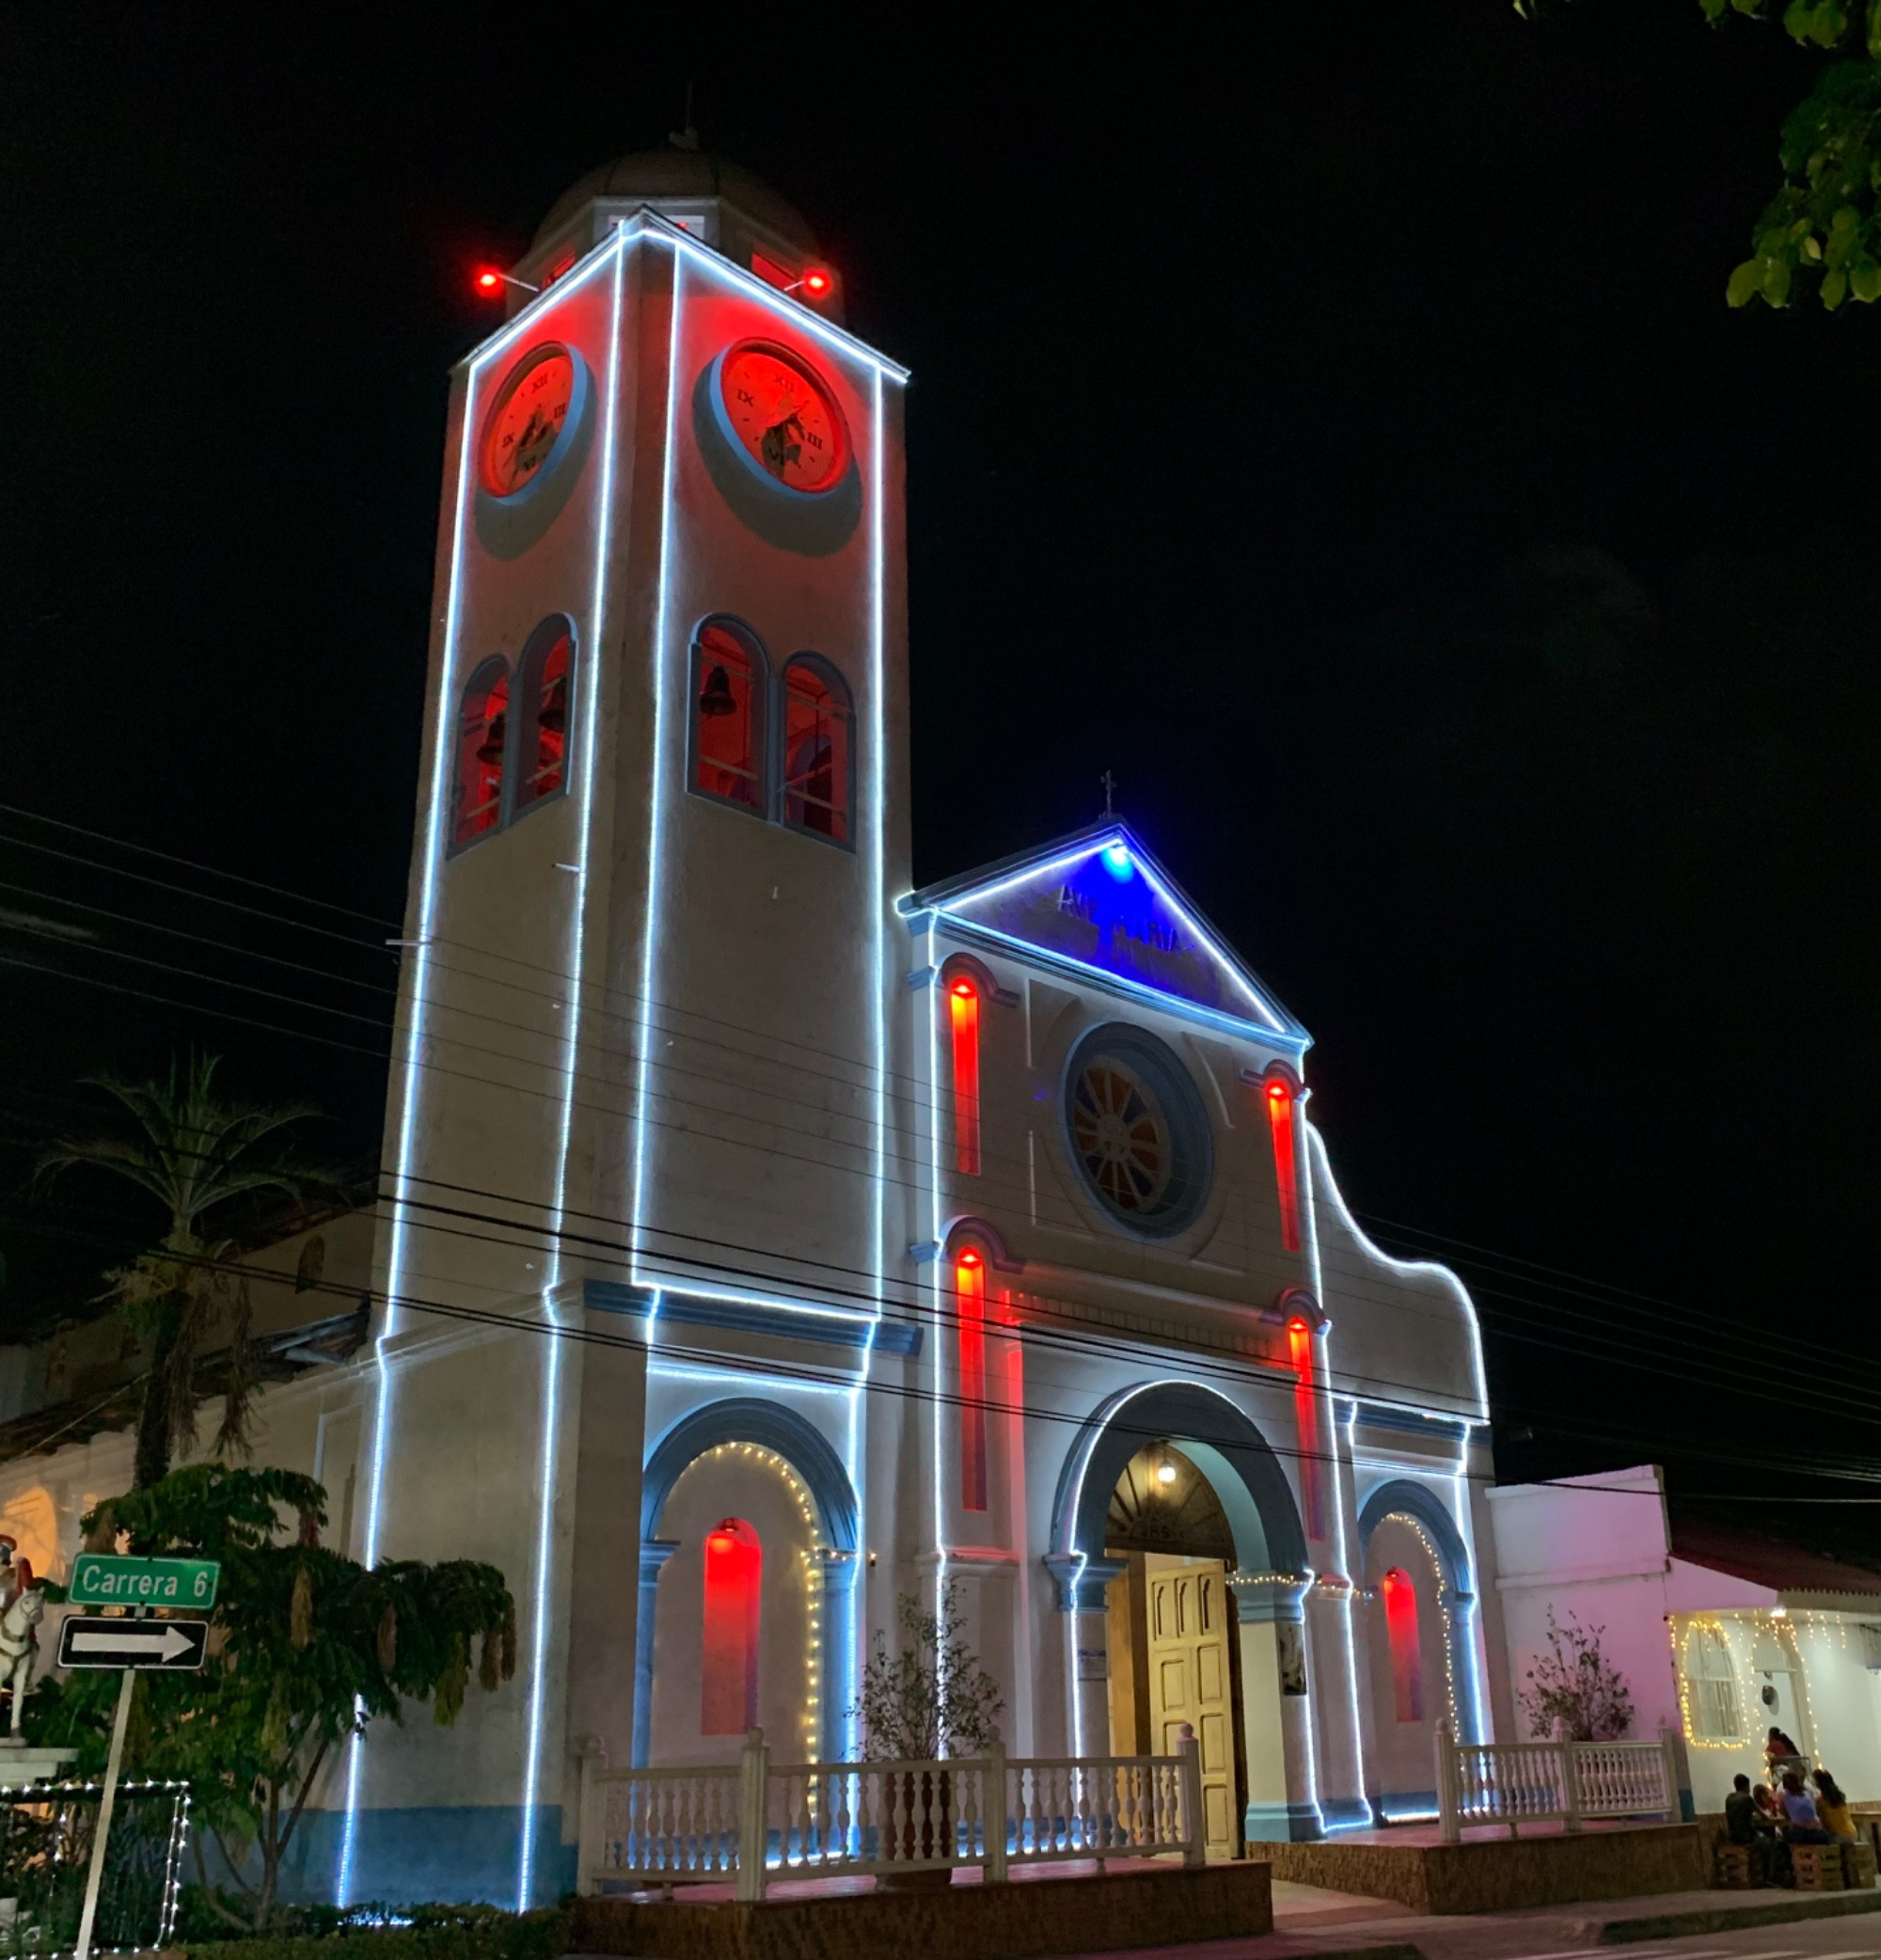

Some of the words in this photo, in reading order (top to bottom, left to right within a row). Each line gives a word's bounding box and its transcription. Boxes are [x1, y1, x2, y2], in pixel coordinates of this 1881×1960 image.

[736, 387, 754, 407] IX
[807, 432, 823, 450] III
[83, 1564, 178, 1596] Carrera
[194, 1571, 208, 1598] 6
